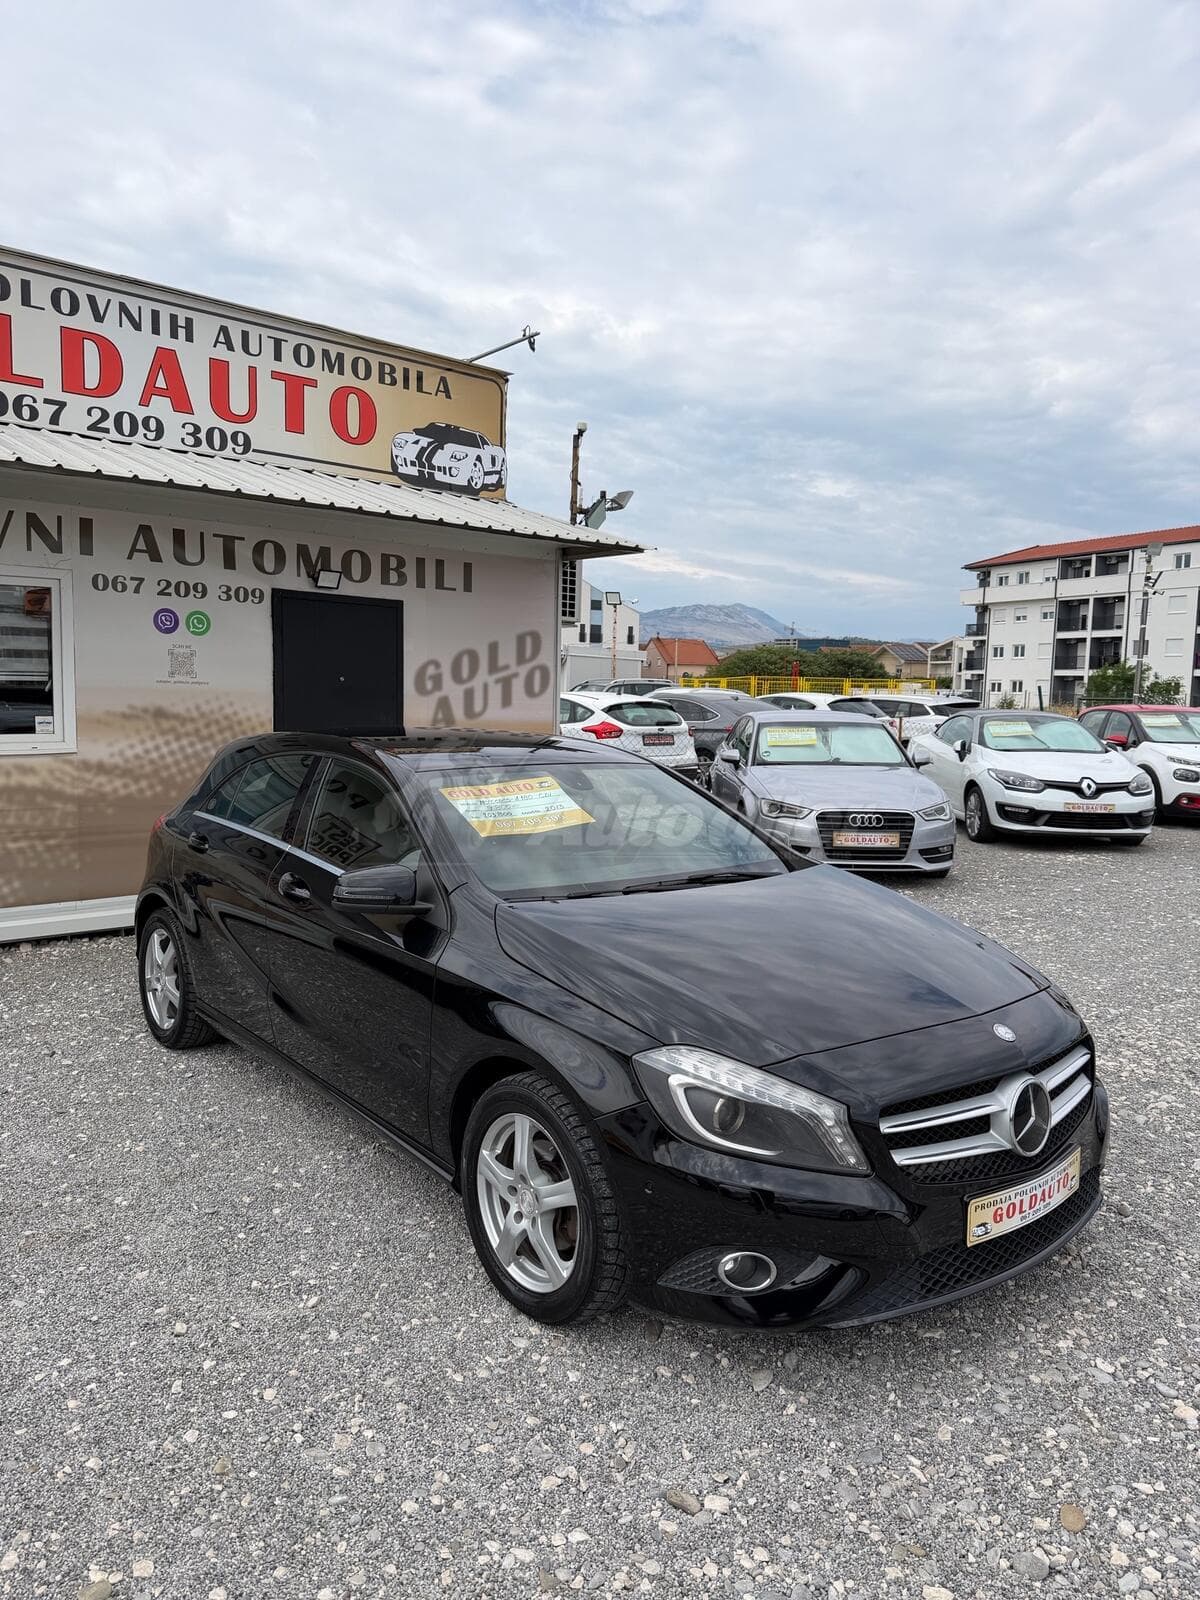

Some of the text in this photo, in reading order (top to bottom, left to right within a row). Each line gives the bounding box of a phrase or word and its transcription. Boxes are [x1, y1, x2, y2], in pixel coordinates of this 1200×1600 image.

[0, 312, 377, 446] LDAUTO
[213, 325, 452, 400] AUTOMOBILA
[86, 406, 165, 441] 209
[180, 422, 252, 455] 309
[126, 524, 473, 592] AUTOMOBILI
[91, 573, 265, 604] 067 209 309
[414, 630, 542, 696] GOLD
[431, 664, 550, 727] AUTO
[448, 782, 534, 798] GOLD AUTO
[974, 1194, 1012, 1212] PRODAJA
[993, 1172, 1069, 1224] GOLDAUTO
